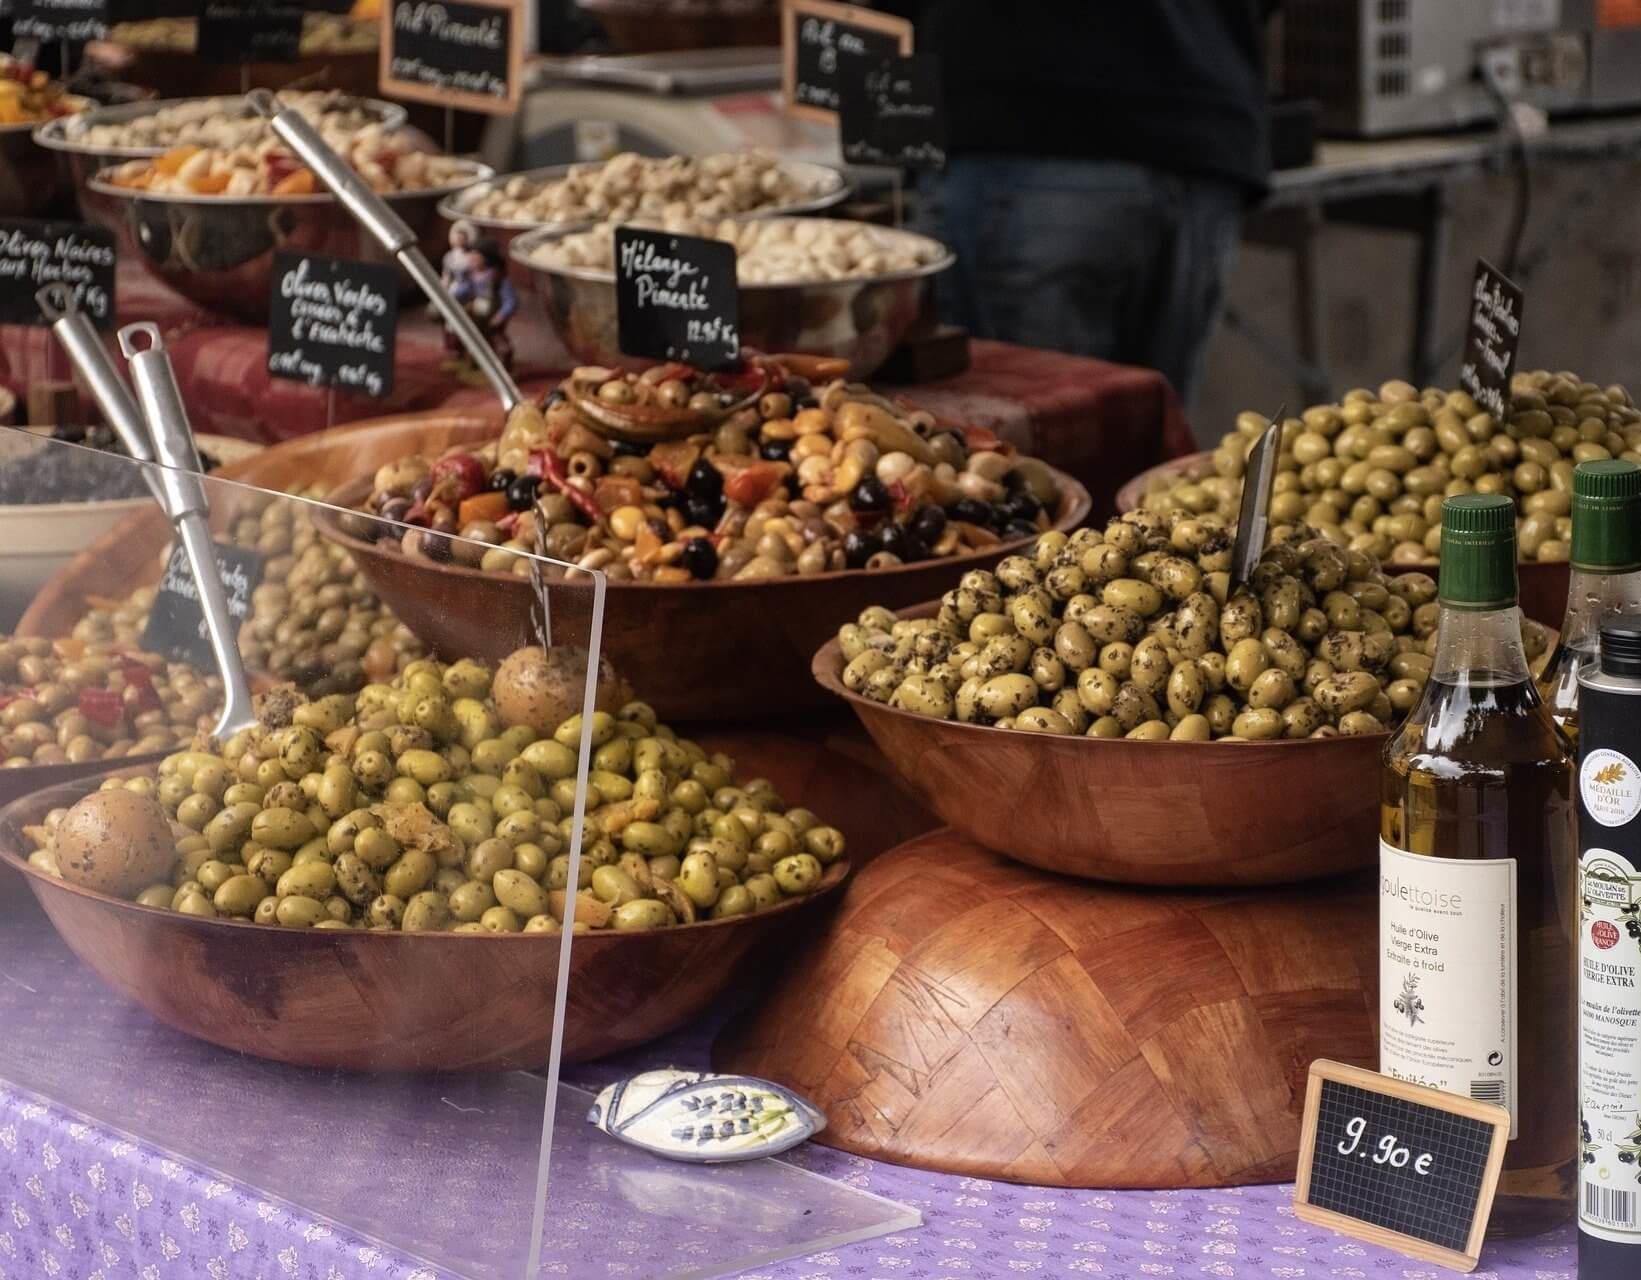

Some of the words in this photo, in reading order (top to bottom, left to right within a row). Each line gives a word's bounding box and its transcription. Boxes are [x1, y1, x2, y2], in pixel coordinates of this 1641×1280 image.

[54, 234, 113, 266] Noires
[621, 239, 699, 288] Mélange
[635, 274, 709, 310] Pimenté
[1589, 783, 1632, 798] MÉDAILLE
[1597, 794, 1620, 806] D'OR
[1390, 921, 1407, 934] Huile
[1409, 928, 1439, 942] d'Olive
[1391, 935, 1412, 952] Vierge
[1414, 943, 1438, 956] Extra
[1422, 960, 1445, 972] froid
[1601, 963, 1635, 977] D'OLIVE
[1606, 975, 1635, 988] EXTRA
[1596, 1013, 1637, 1027] MANOSQUE
